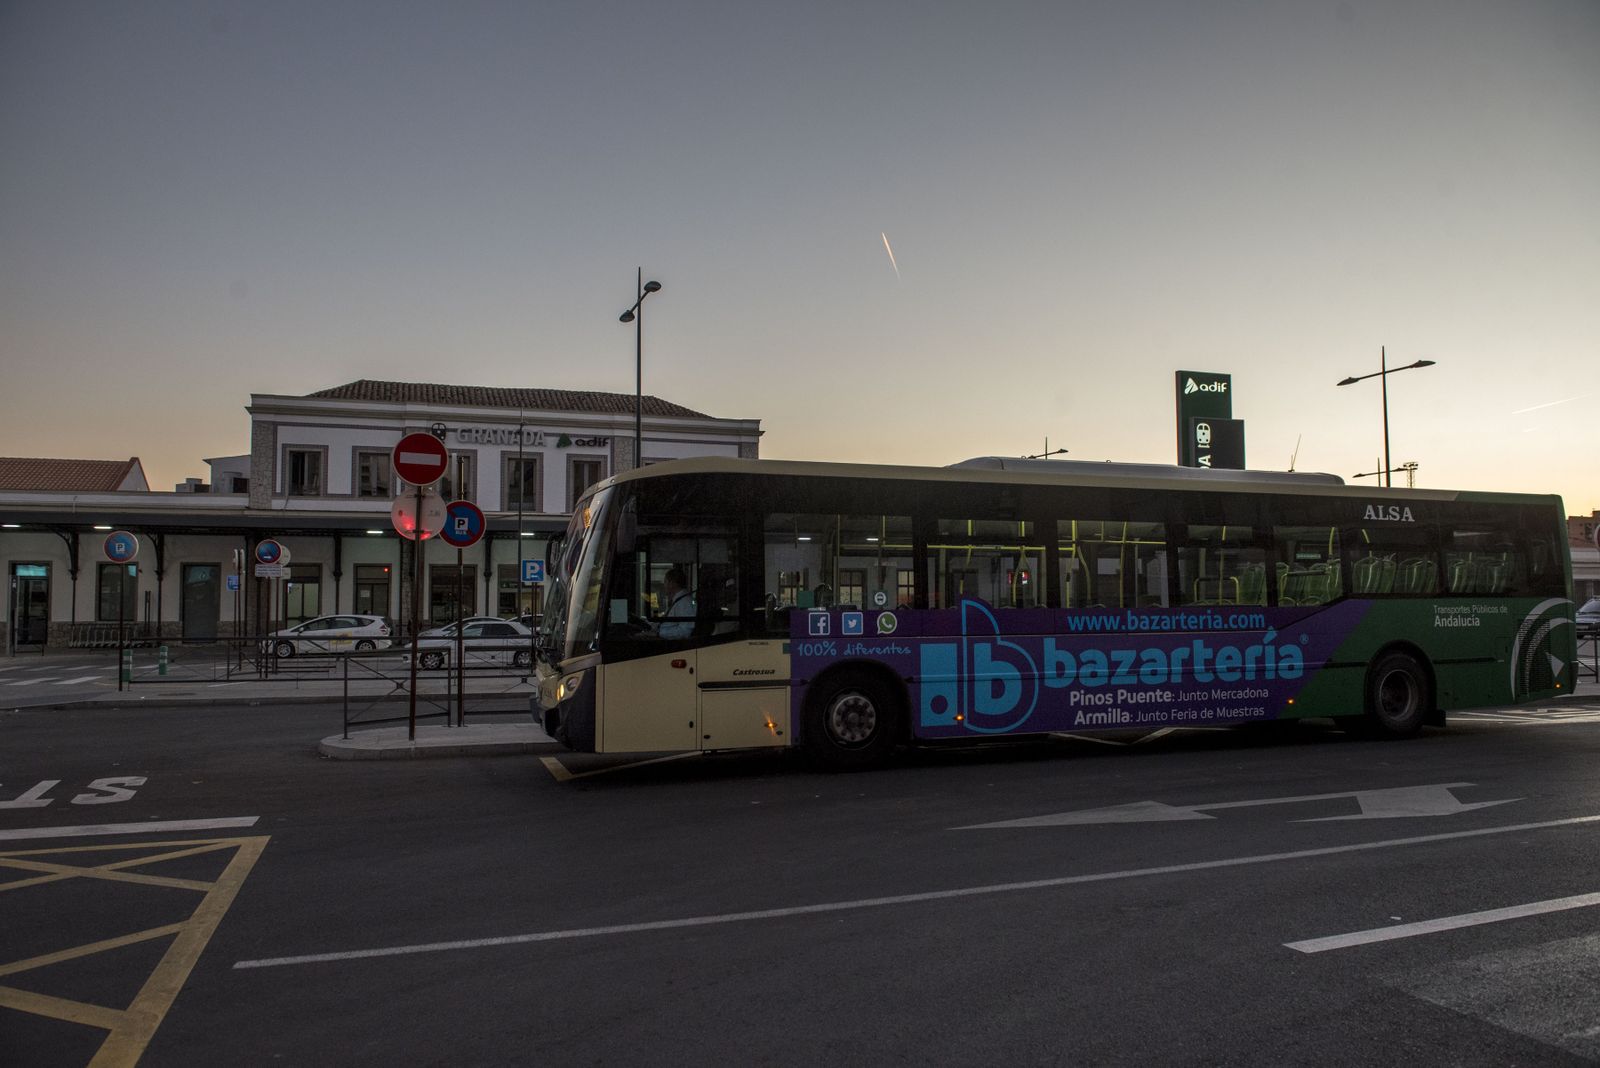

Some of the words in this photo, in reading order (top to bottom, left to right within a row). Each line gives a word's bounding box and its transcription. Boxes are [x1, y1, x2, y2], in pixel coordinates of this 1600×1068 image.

[1199, 382, 1227, 392] adif
[456, 428, 546, 447] GRANADA
[575, 437, 610, 447] adif
[1198, 454, 1212, 470] A
[1363, 505, 1415, 522] ALSA
[457, 519, 466, 529] P
[526, 561, 541, 579] P
[1433, 605, 1471, 615] Transportes
[1472, 604, 1499, 614] Públicos
[1500, 604, 1508, 613] de
[1067, 608, 1266, 632] www.bazarteria.com
[1434, 614, 1480, 628] Andalucía
[797, 641, 838, 656] 100%
[843, 643, 912, 656] diferentes
[1069, 690, 1114, 706] Pinos
[1117, 688, 1176, 705] Puente:
[1177, 689, 1208, 701] Junto
[1211, 687, 1269, 700] Mercadona
[1074, 708, 1134, 726] Armilla:
[1136, 710, 1168, 722] Junto
[1171, 708, 1197, 721] Feria
[1200, 708, 1214, 720] de
[1217, 706, 1265, 719] Muestras
[0, 776, 148, 809] ST
